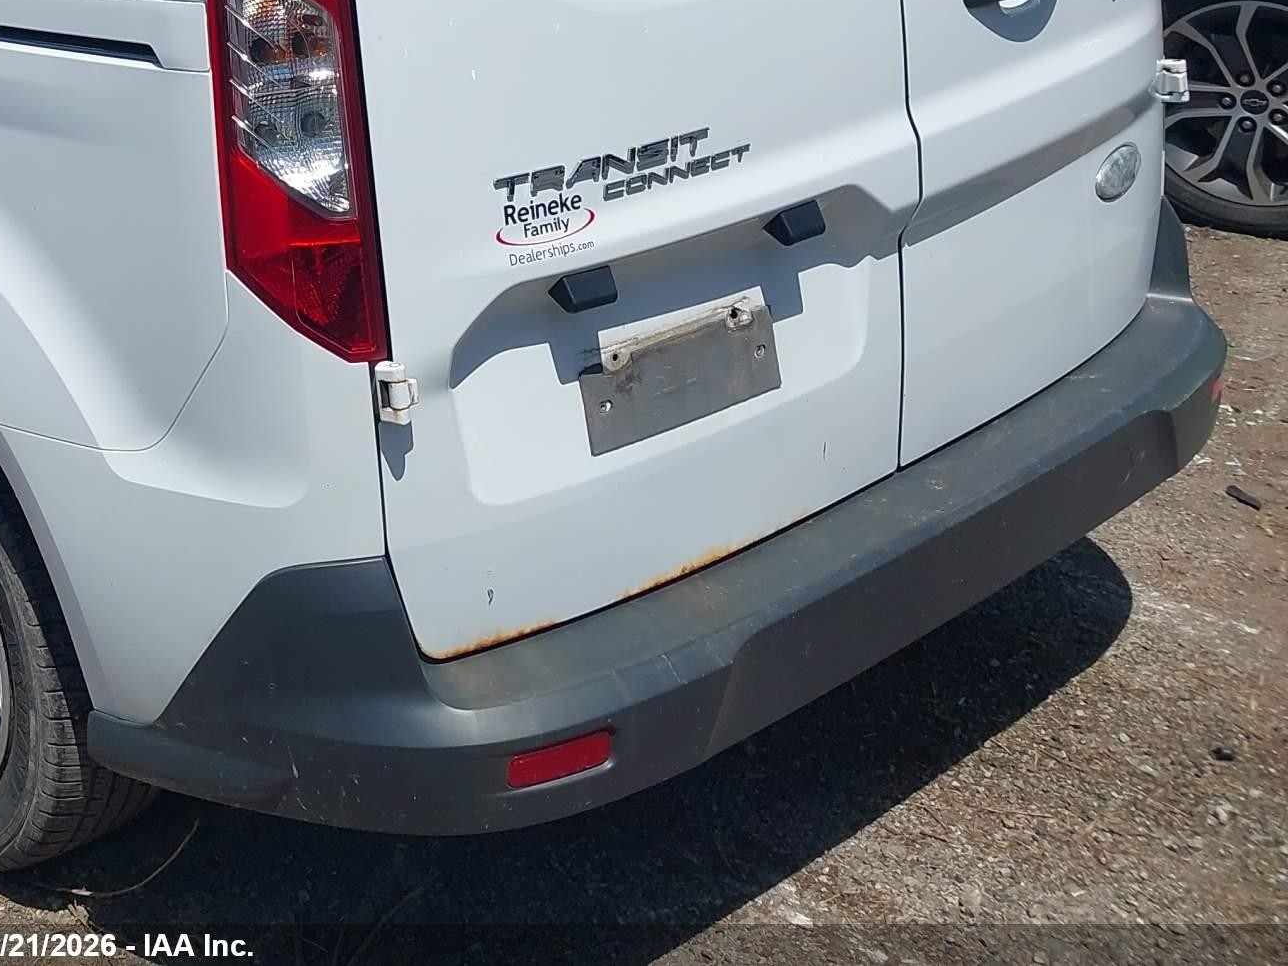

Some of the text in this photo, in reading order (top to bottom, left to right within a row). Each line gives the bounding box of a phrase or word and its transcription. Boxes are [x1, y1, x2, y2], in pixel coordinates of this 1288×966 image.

[492, 126, 710, 202] TRANSIT
[602, 143, 751, 202] CONNECT
[503, 194, 582, 226] Reineke
[523, 216, 571, 239] Family
[509, 239, 595, 267] Dealerships.com
